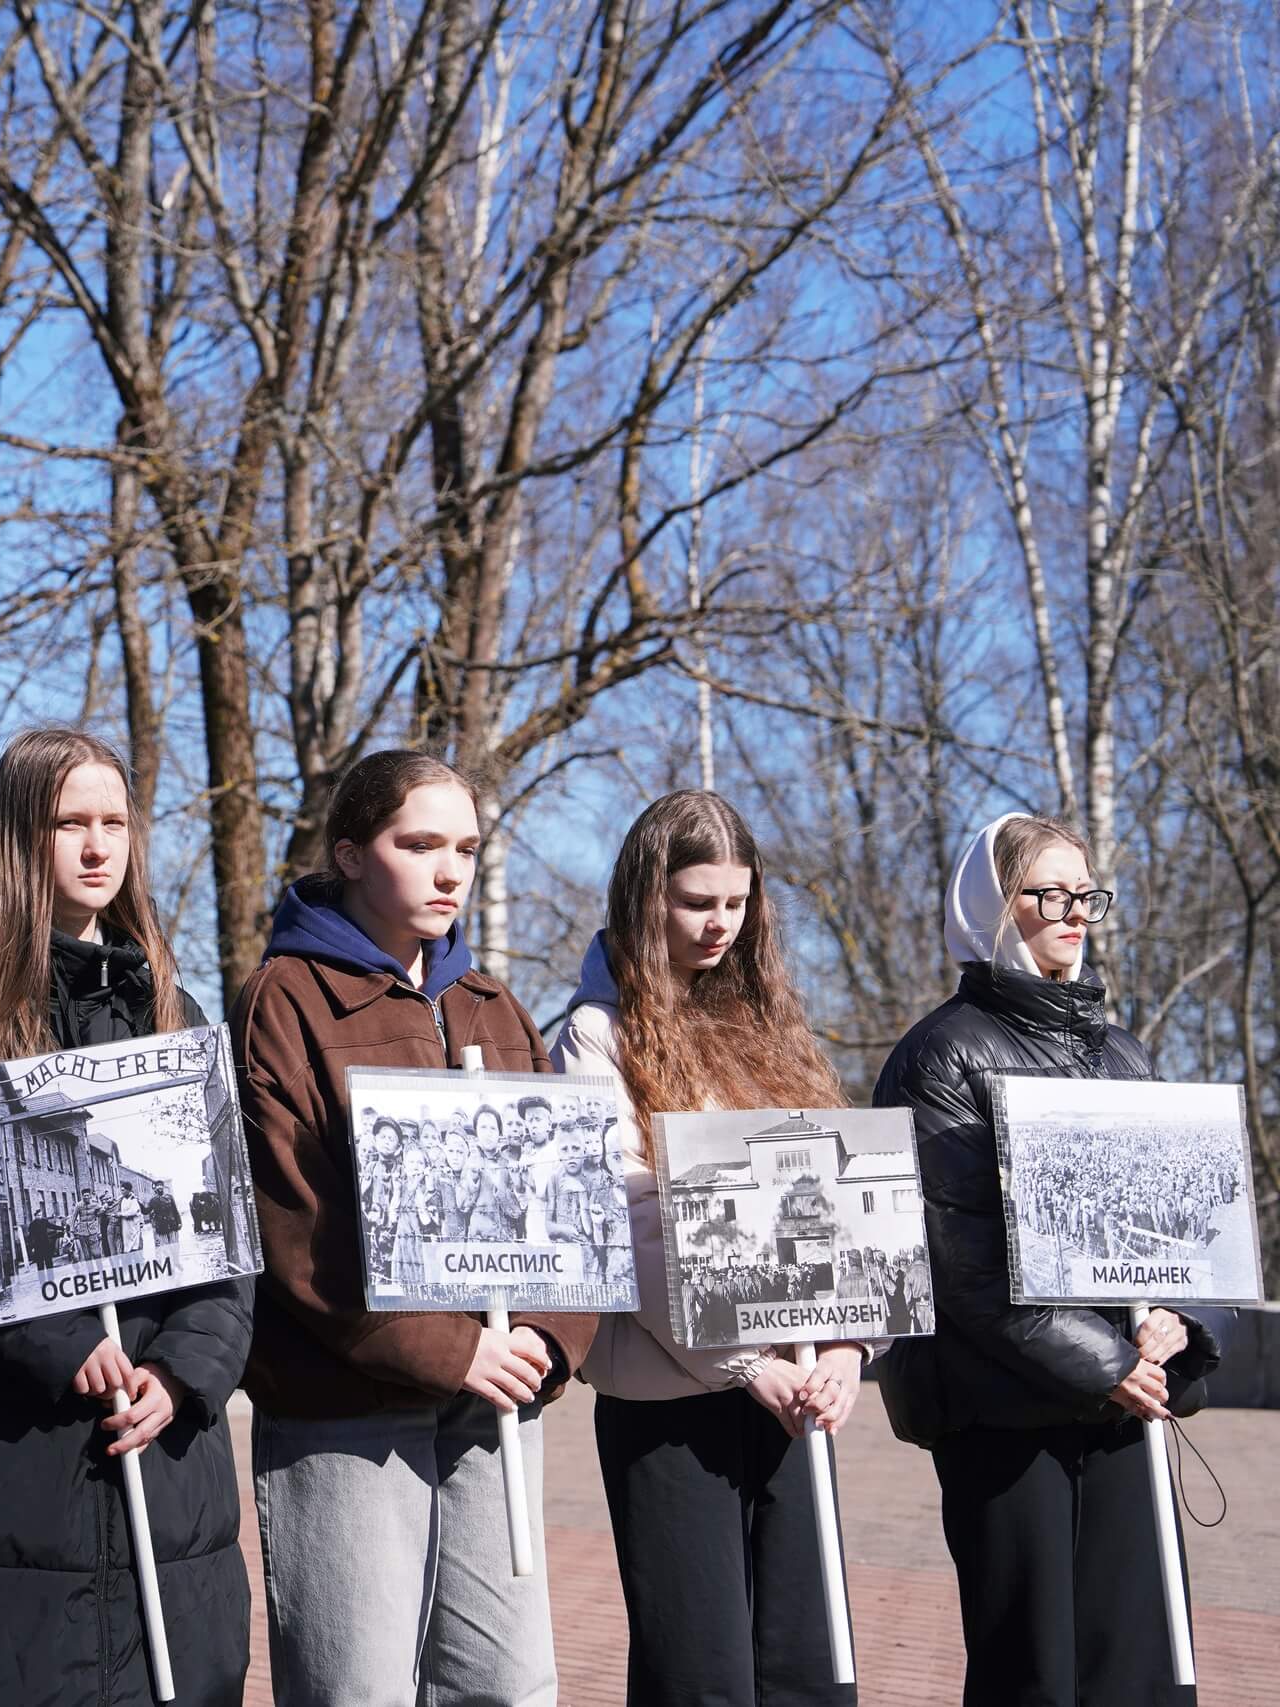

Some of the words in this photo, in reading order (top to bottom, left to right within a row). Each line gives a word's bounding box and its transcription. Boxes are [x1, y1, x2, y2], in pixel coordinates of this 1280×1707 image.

[24, 1055, 101, 1095] MACHT
[116, 1049, 182, 1079] FREI
[444, 1252, 564, 1274] САЛАСПИЛС
[1092, 1261, 1192, 1287] МАЙДАНЕК
[41, 1256, 173, 1302] ОСВЕНЦИМ
[739, 1303, 883, 1330] ЗАКСЕНХАУЗЕН
